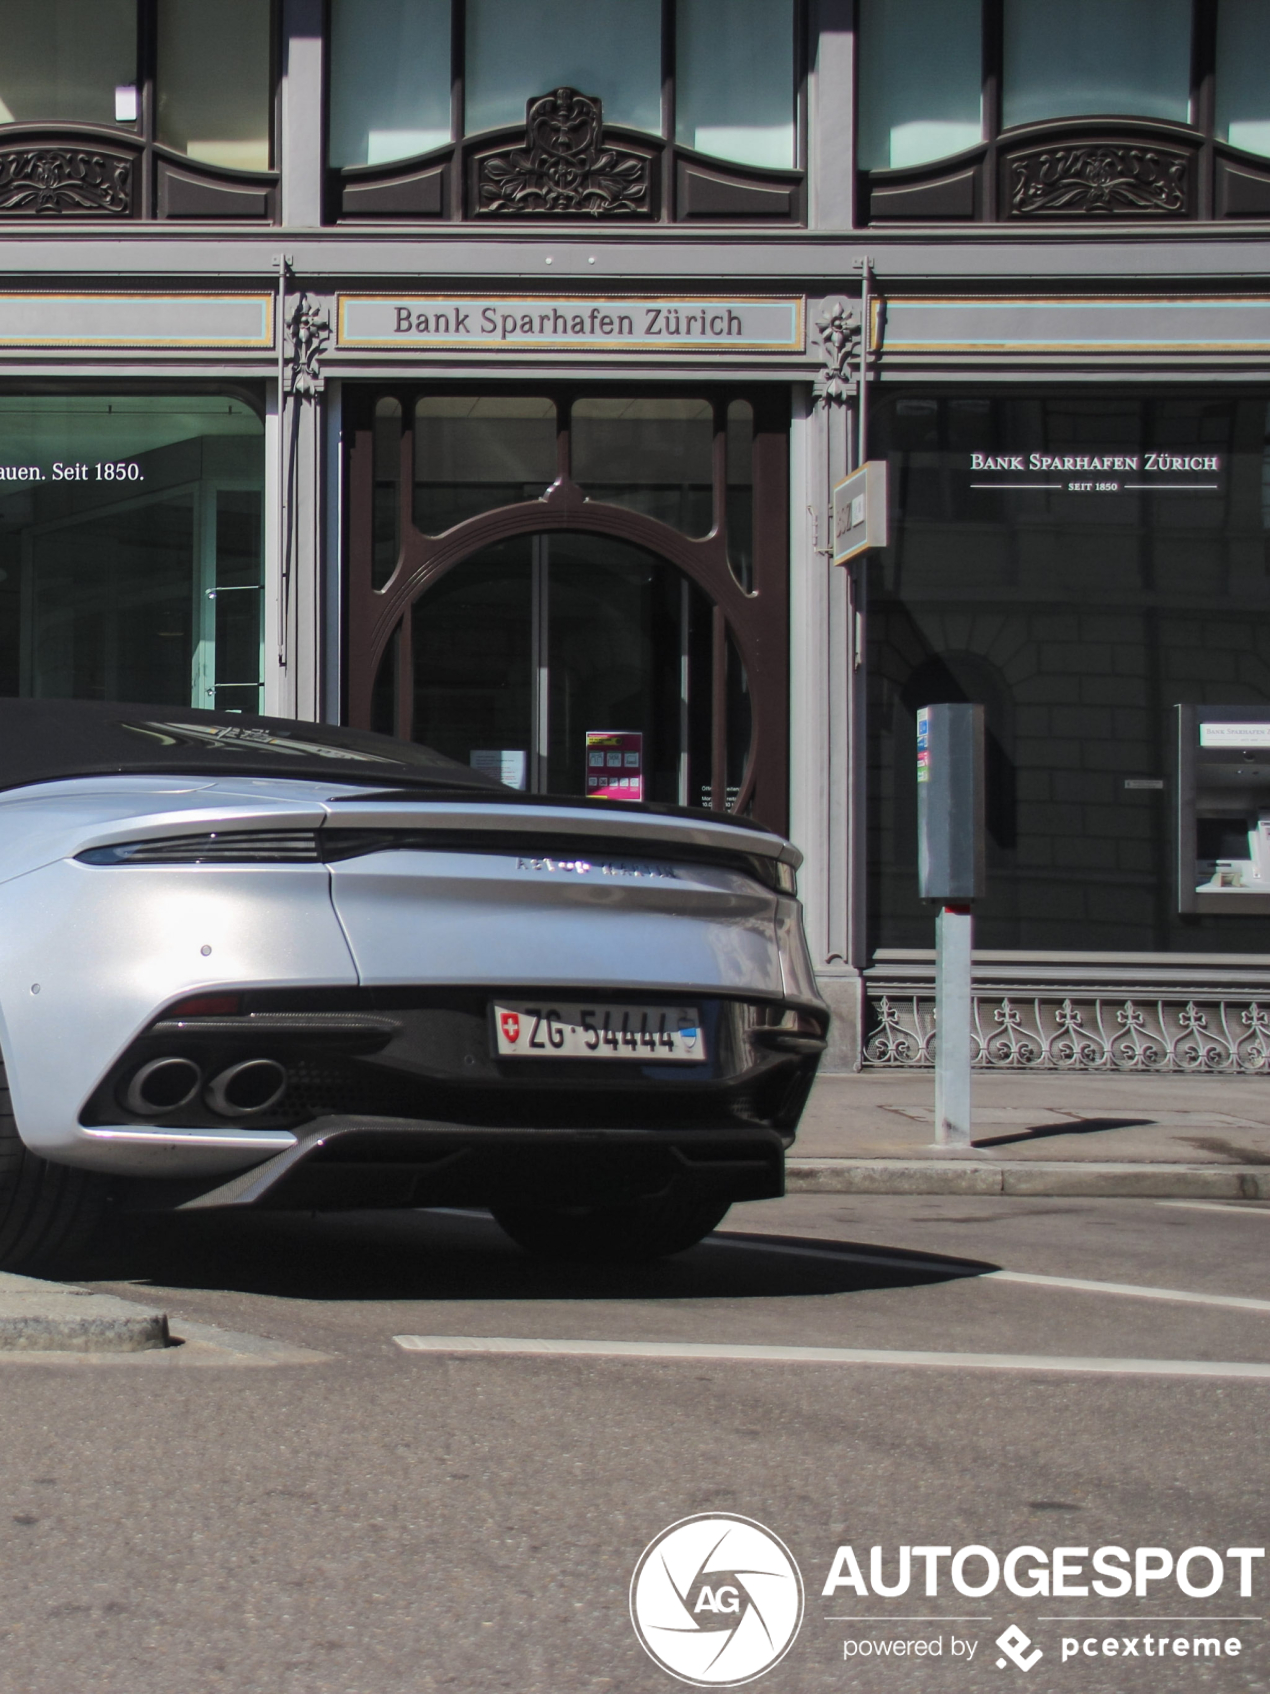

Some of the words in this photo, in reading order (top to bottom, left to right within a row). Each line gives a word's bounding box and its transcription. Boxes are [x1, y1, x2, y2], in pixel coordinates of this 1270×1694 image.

[393, 306, 471, 334] Bank
[480, 307, 634, 340] Sparhafen
[644, 308, 743, 337] Zürich
[969, 453, 1025, 471] BANK
[1029, 453, 1139, 471] SPARHAFEN
[1144, 453, 1219, 471] ZÜRICH
[52, 462, 89, 481] Seit
[94, 462, 145, 481] 1850.
[1067, 482, 1093, 492] SEIT
[1095, 482, 1118, 492] 1850
